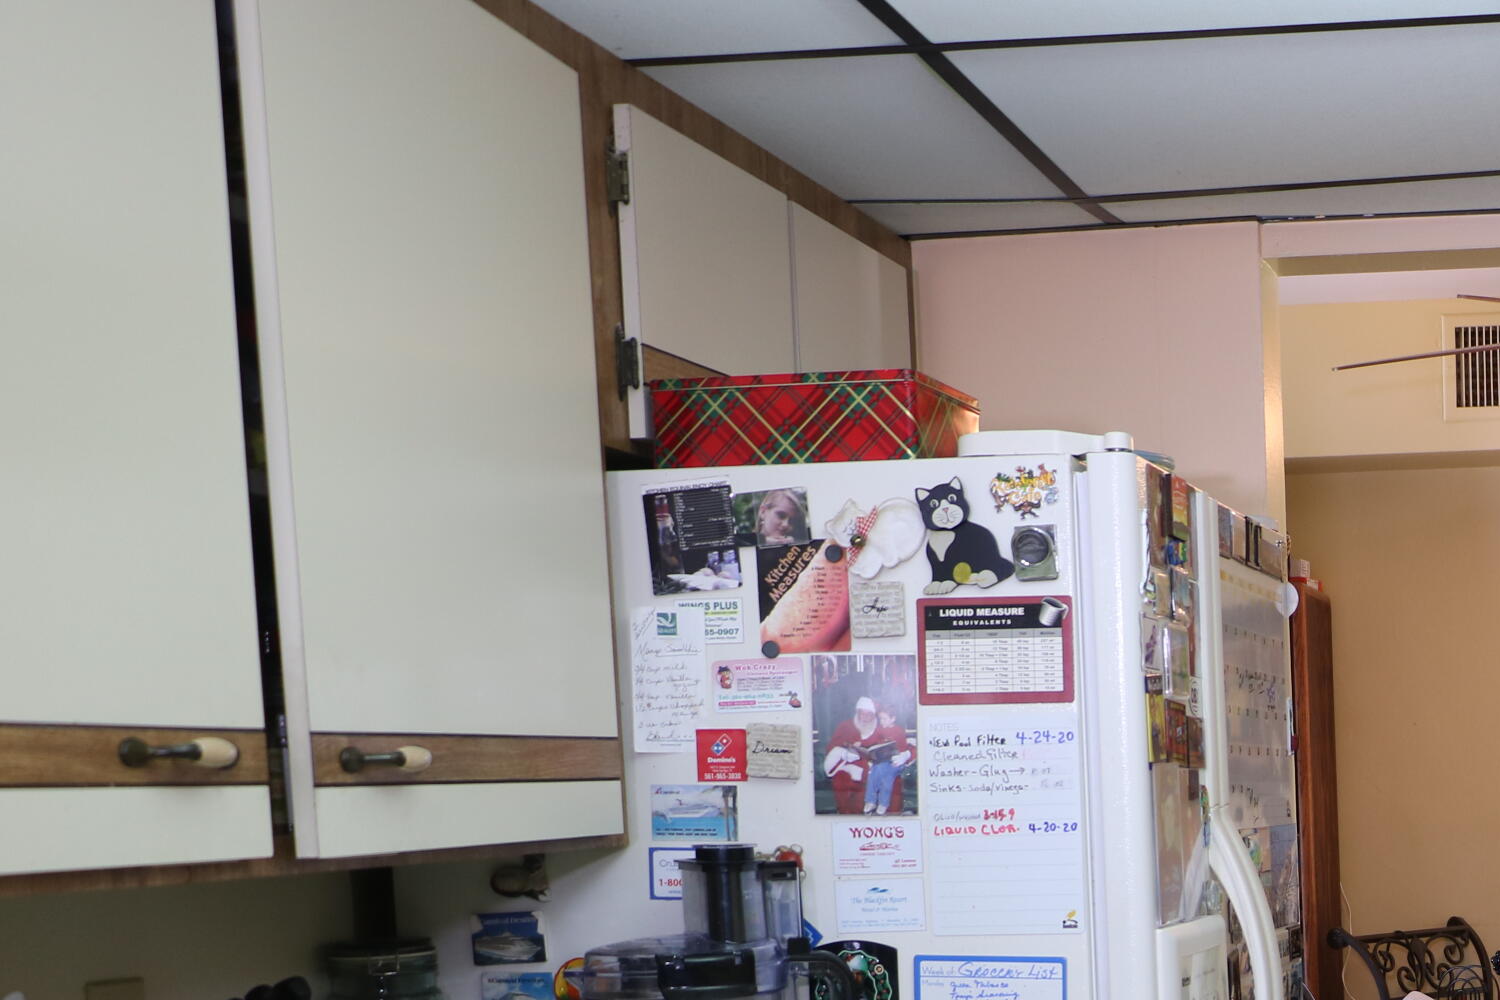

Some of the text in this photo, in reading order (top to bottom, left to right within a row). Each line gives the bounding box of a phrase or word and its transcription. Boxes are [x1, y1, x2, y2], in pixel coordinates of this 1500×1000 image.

[764, 546, 800, 586] Kitchen
[769, 545, 816, 602] Measures
[713, 601, 738, 610] PLUS
[939, 607, 1025, 617] LIQUID MEASURE
[1016, 730, 1074, 744] 4-24-20
[752, 740, 793, 754] Dream
[849, 826, 905, 838] WONG'S
[934, 826, 977, 836] LIQUID
